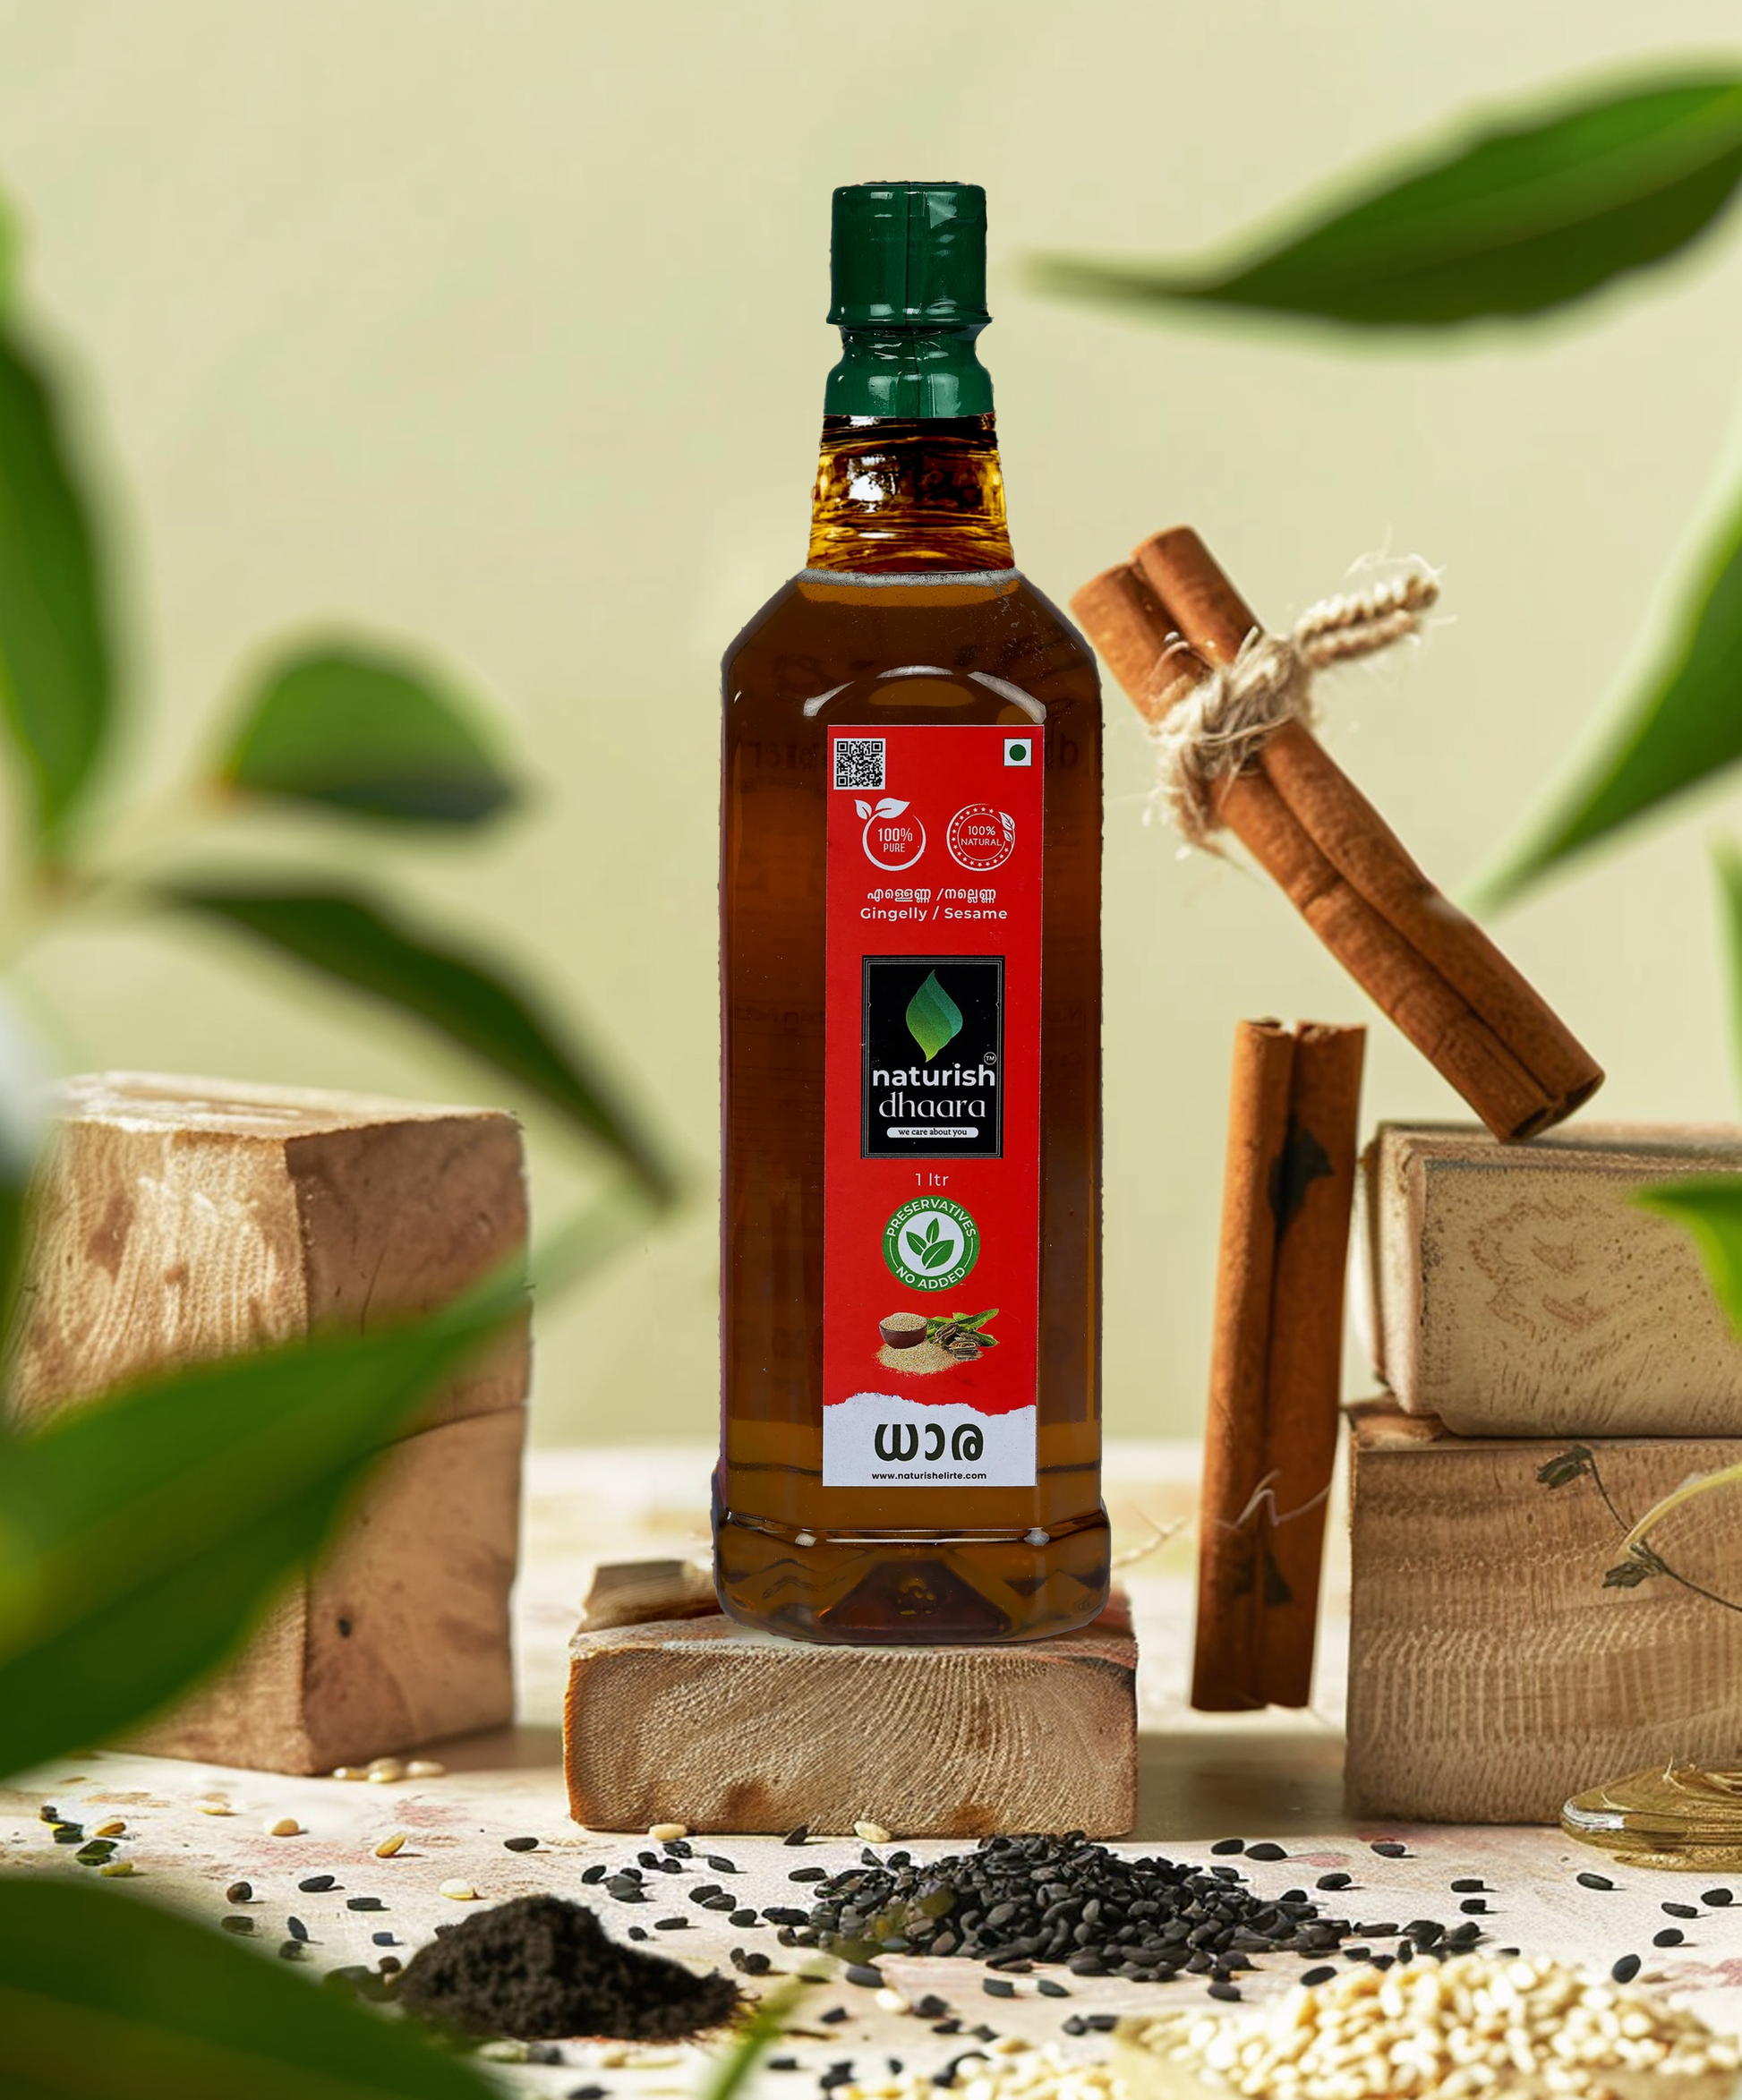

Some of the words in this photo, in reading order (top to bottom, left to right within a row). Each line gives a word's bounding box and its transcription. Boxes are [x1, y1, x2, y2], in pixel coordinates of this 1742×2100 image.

[877, 828, 912, 841] 100%
[968, 826, 995, 835] 100%
[884, 843, 905, 852] PURE
[961, 838, 1002, 846] NATURAL
[859, 907, 927, 922] Gingelly
[944, 908, 1008, 919] Sesame
[873, 1063, 995, 1086] naturish
[879, 1091, 986, 1117] dhaara
[929, 1128, 951, 1136] about
[915, 1174, 921, 1186] 1
[928, 1173, 949, 1186] ltr
[886, 1198, 976, 1237] PRESERVATIVES
[896, 1266, 916, 1284] NO
[918, 1267, 965, 1289] ADDED
[875, 1423, 984, 1462] ധാര
[872, 1472, 986, 1480] www.naturishelirte.com
